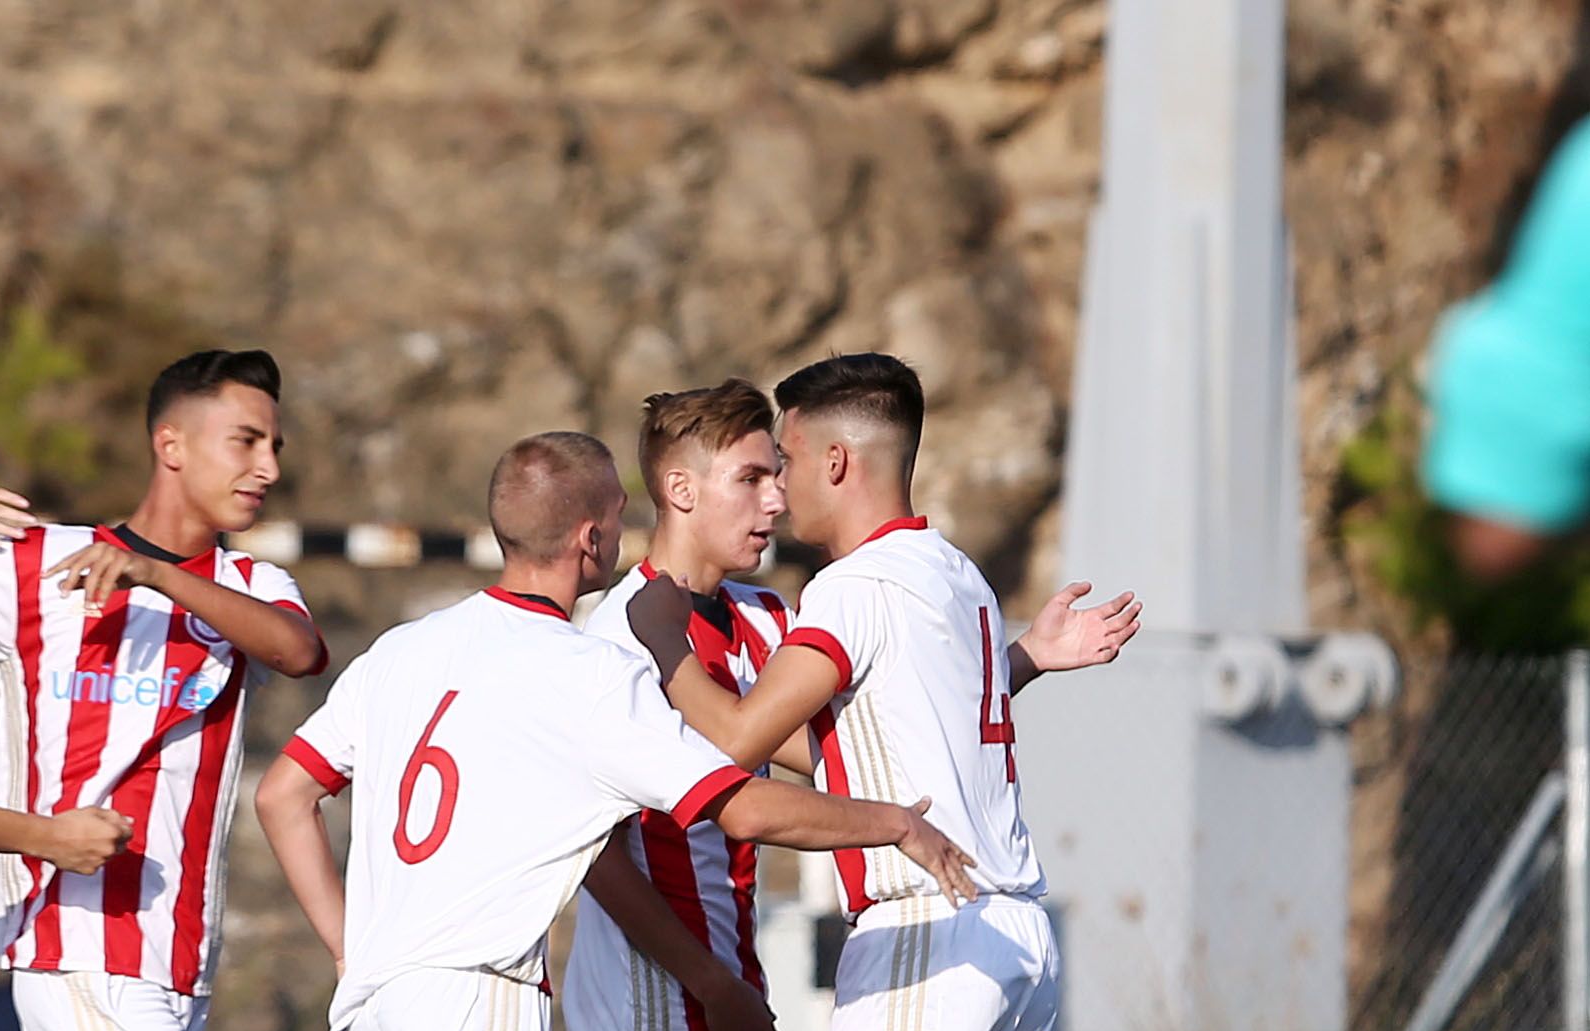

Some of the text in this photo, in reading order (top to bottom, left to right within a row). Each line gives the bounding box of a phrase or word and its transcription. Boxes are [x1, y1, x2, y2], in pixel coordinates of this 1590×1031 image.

[51, 664, 181, 708] unicef
[978, 606, 1016, 784] 4
[392, 689, 461, 865] 6
